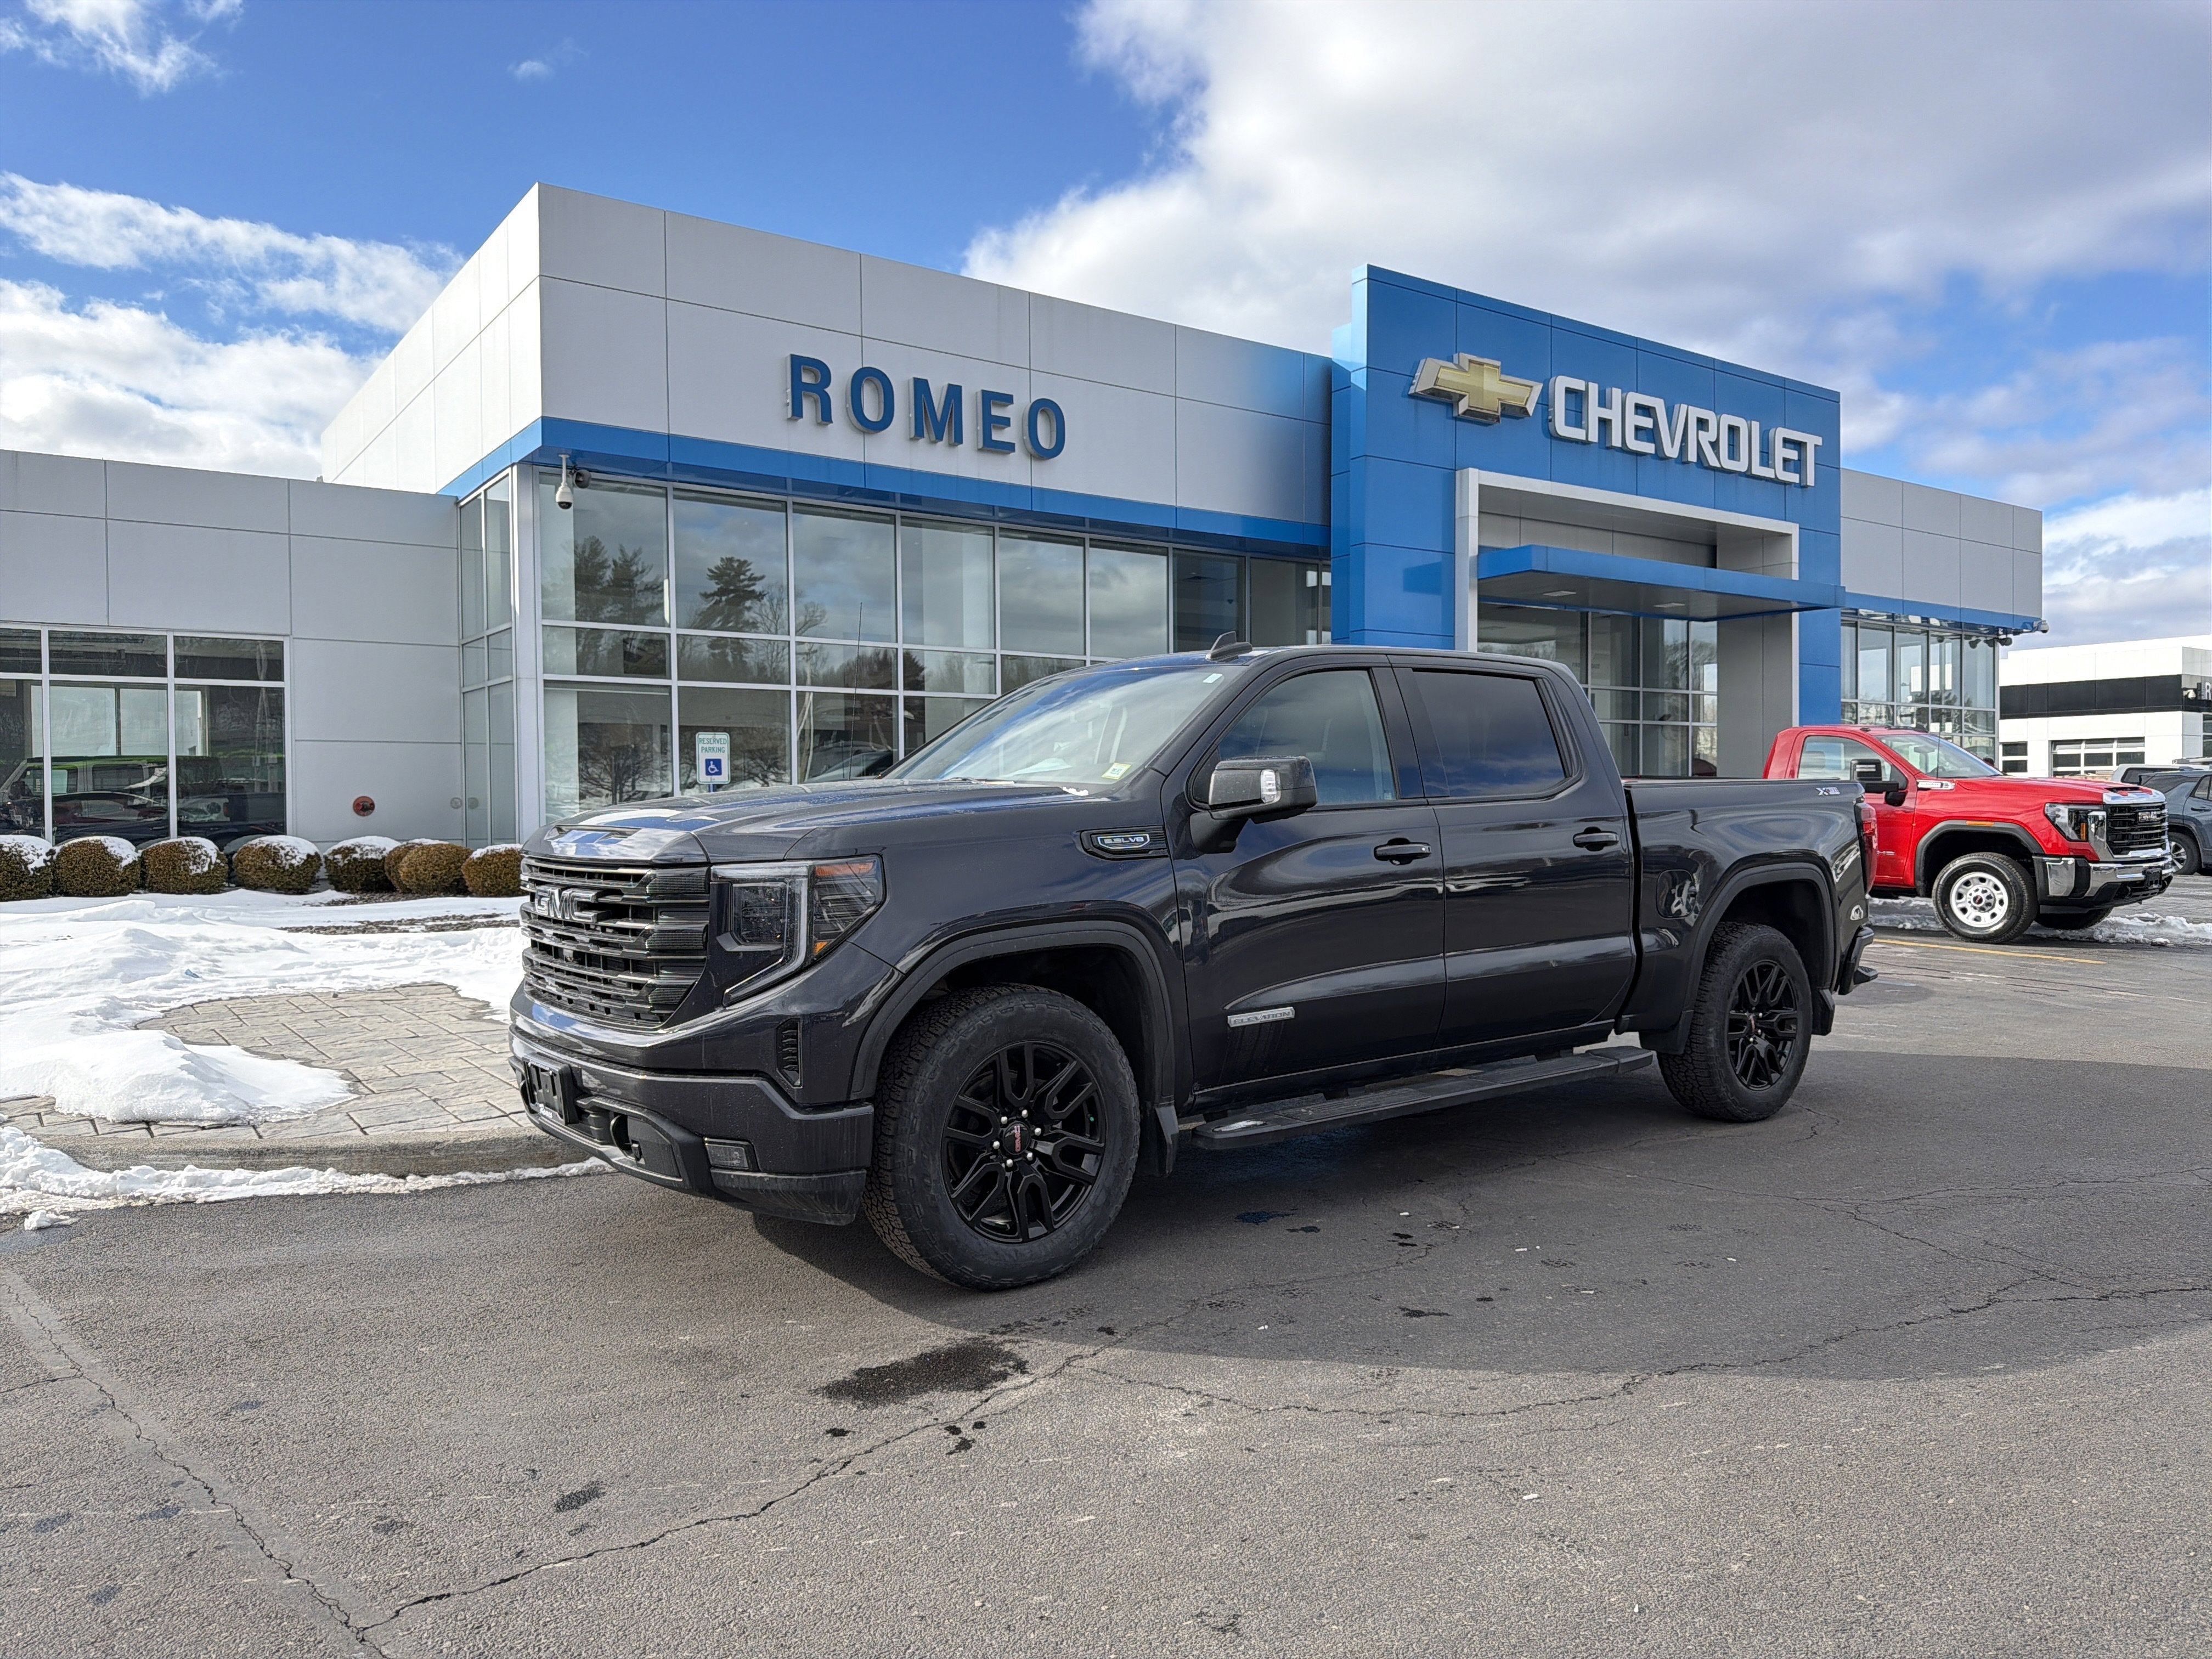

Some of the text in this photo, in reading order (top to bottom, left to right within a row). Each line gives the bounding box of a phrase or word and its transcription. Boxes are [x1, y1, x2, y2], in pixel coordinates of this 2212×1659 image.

[786, 353, 1065, 460] ROMEO
[1549, 375, 1822, 487] CHEVROLET
[535, 885, 596, 922] GMC
[1233, 1011, 1290, 1024] ELEVATION
